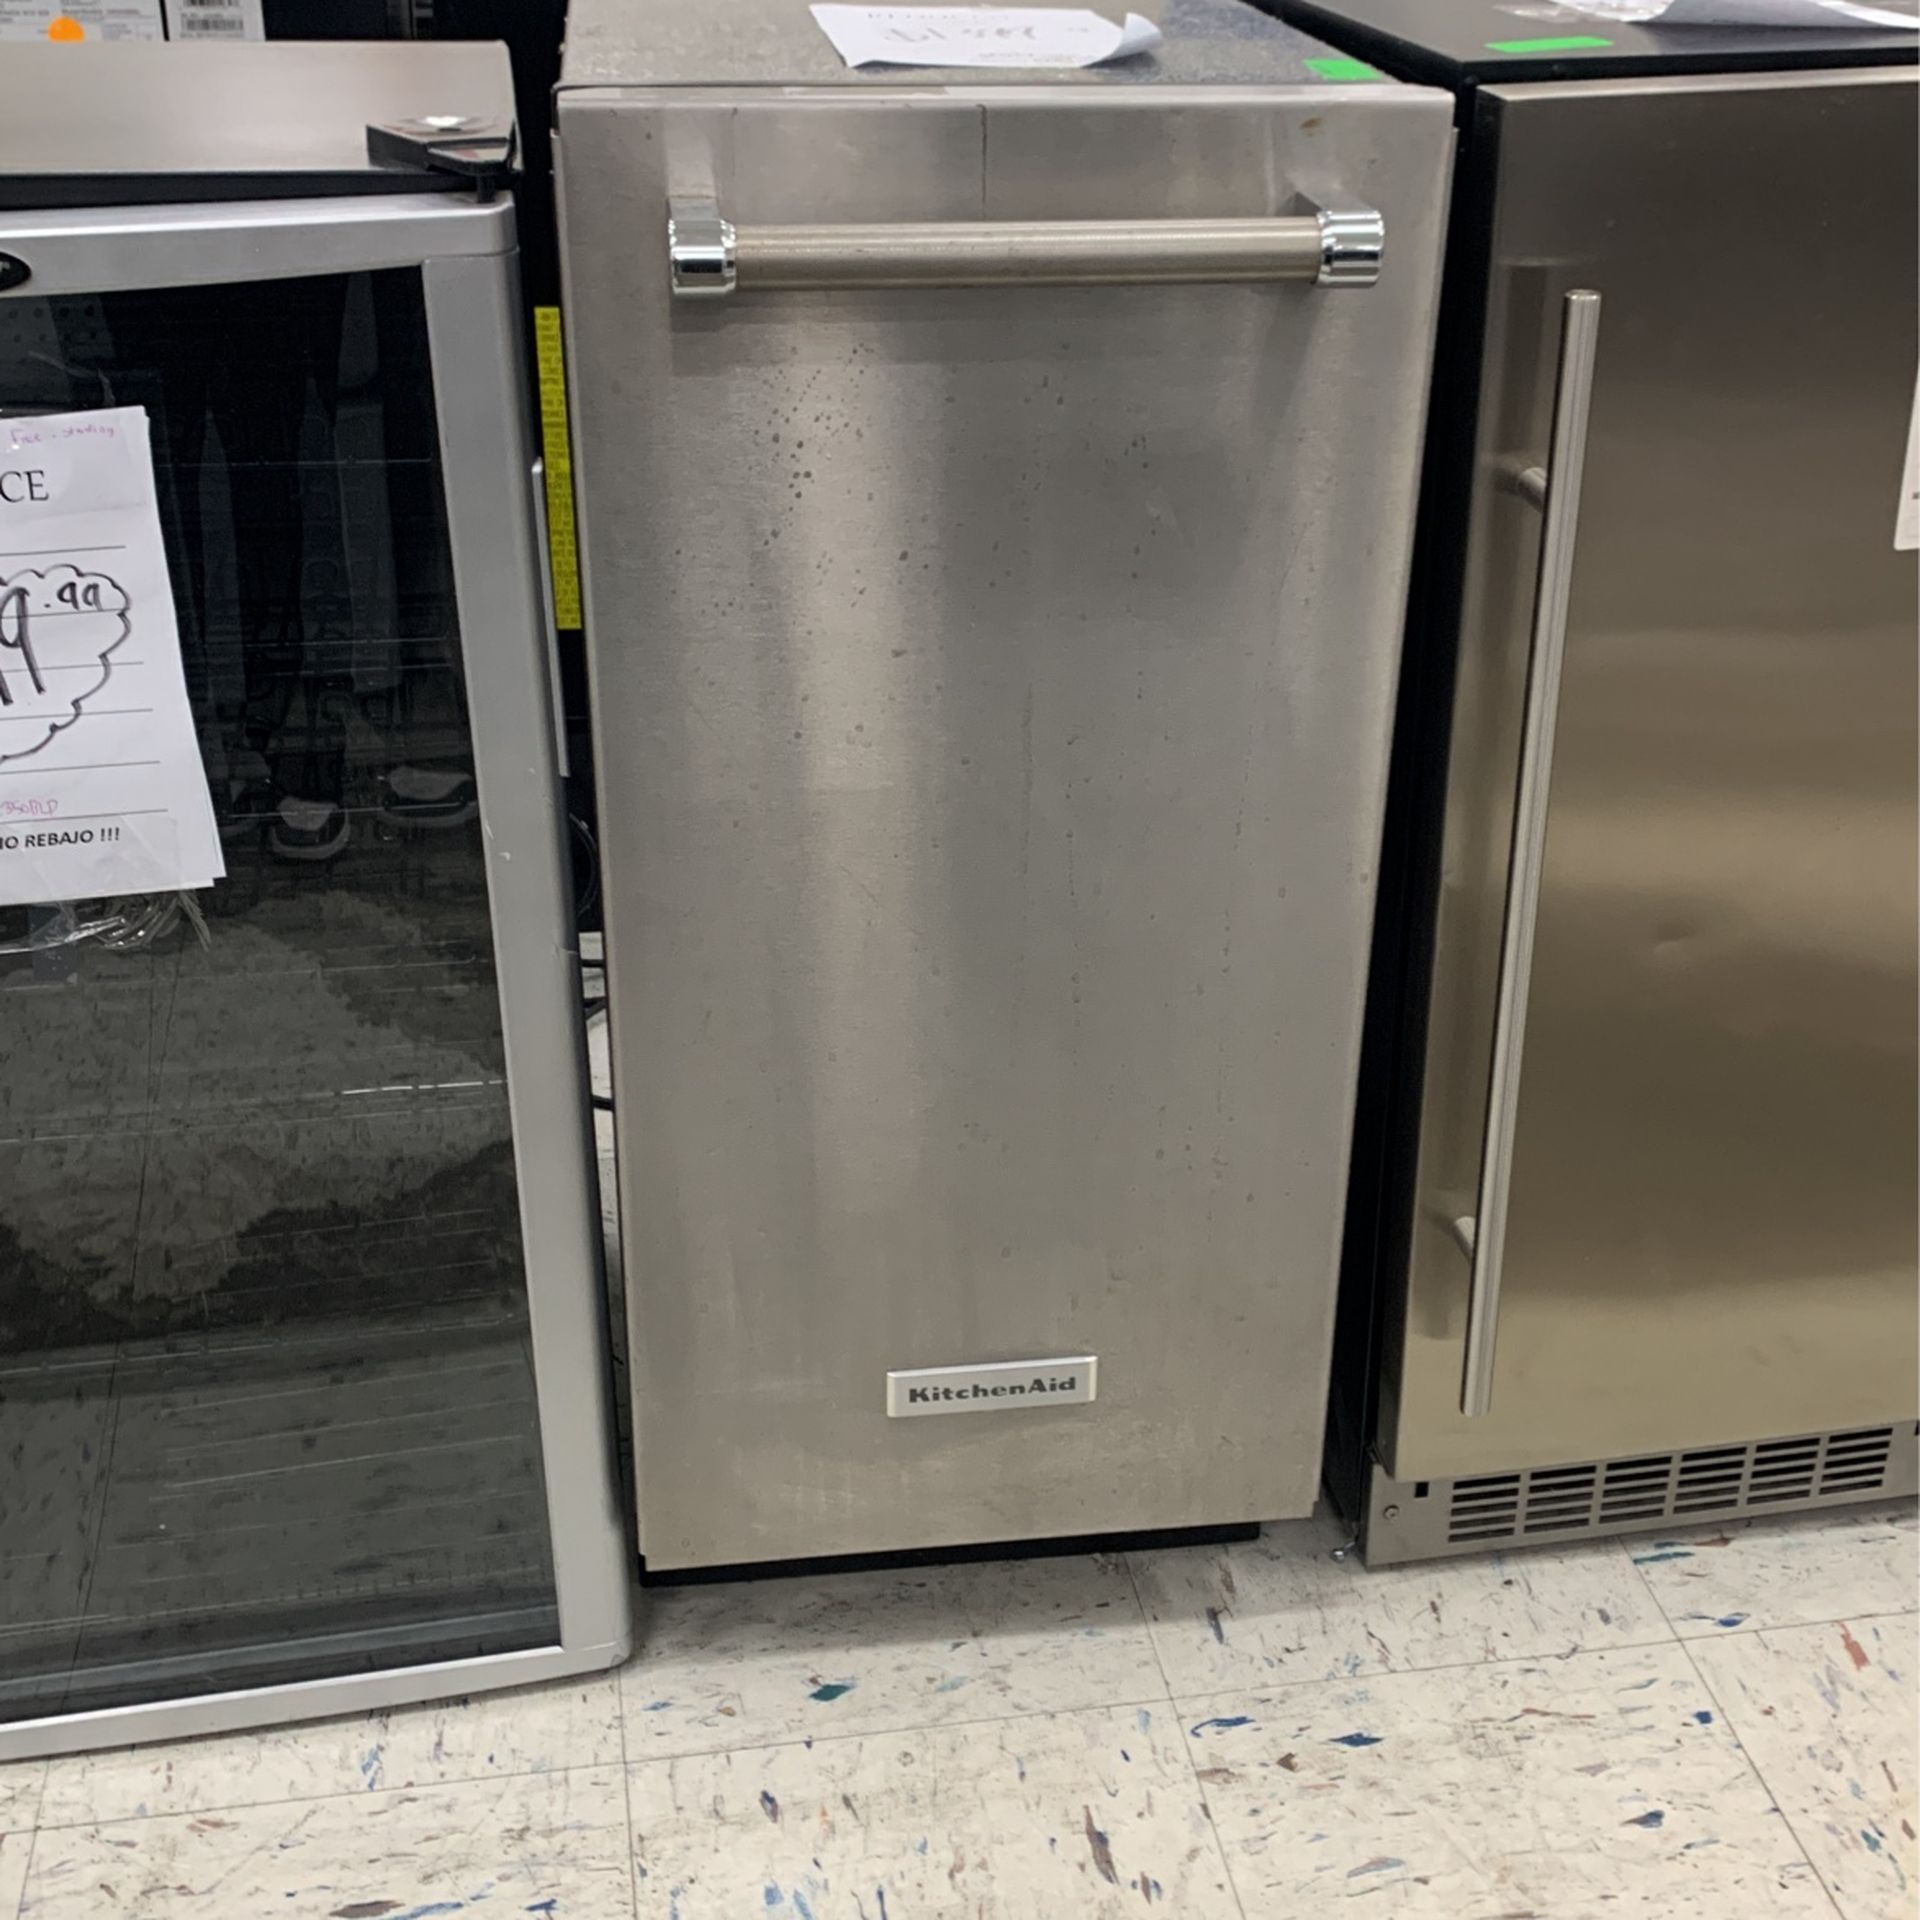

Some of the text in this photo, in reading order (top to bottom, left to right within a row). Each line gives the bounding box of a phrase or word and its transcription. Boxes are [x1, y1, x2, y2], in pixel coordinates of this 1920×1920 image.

[25, 830, 94, 848] REBAJO
[99, 827, 120, 842] !!!
[908, 1376, 1077, 1403] KitchenAid
